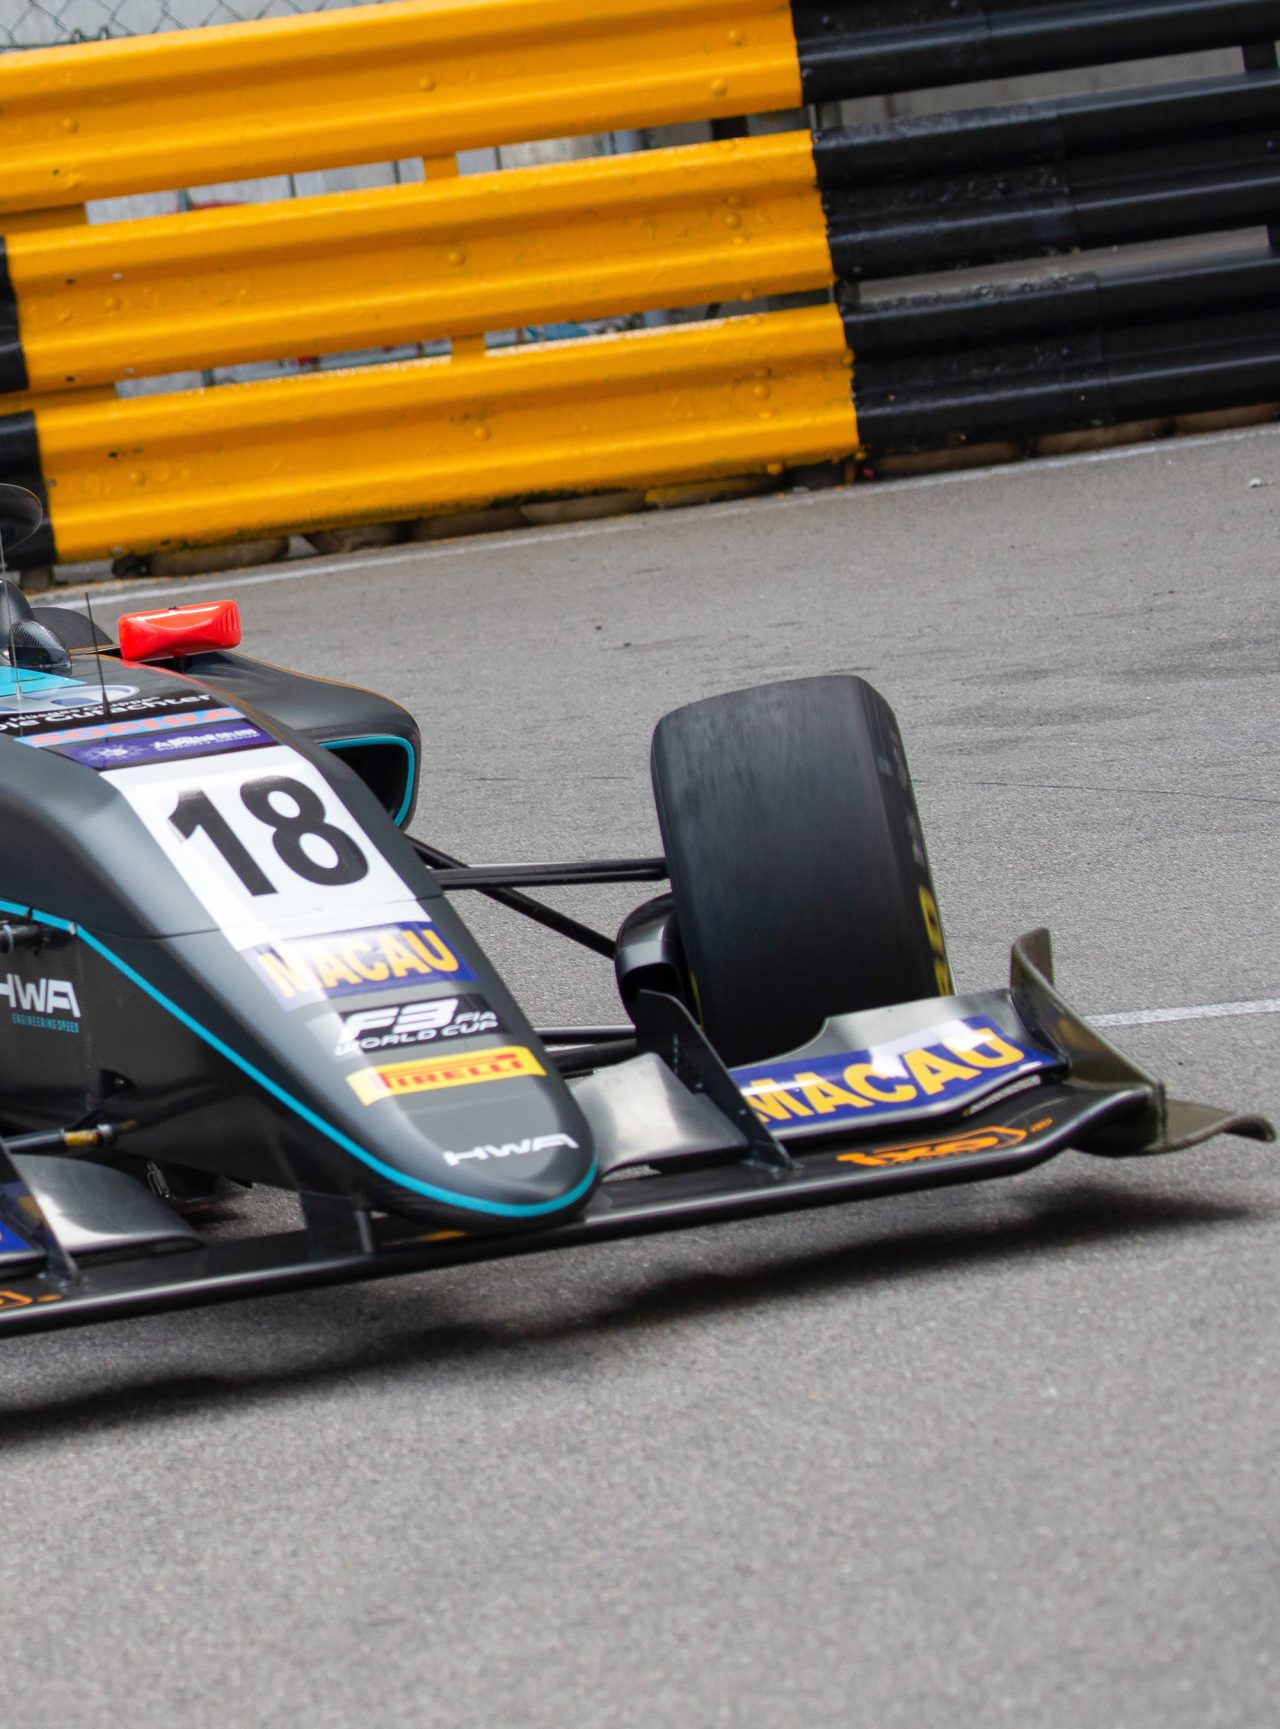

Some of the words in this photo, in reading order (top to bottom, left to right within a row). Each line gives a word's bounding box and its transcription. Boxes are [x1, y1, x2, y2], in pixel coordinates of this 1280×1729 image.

[29, 708, 246, 747] SOPHIA
[45, 694, 211, 722] Gutachter
[168, 774, 369, 898] 18
[257, 929, 460, 998] MACAU
[335, 1028, 437, 1056] WORLD
[441, 1020, 499, 1037] CUP
[338, 998, 460, 1042] F3
[455, 1011, 498, 1026] FIA
[370, 1053, 523, 1089] PIRELLI
[742, 1027, 1025, 1124] MACAU
[442, 1132, 580, 1167] HWA
